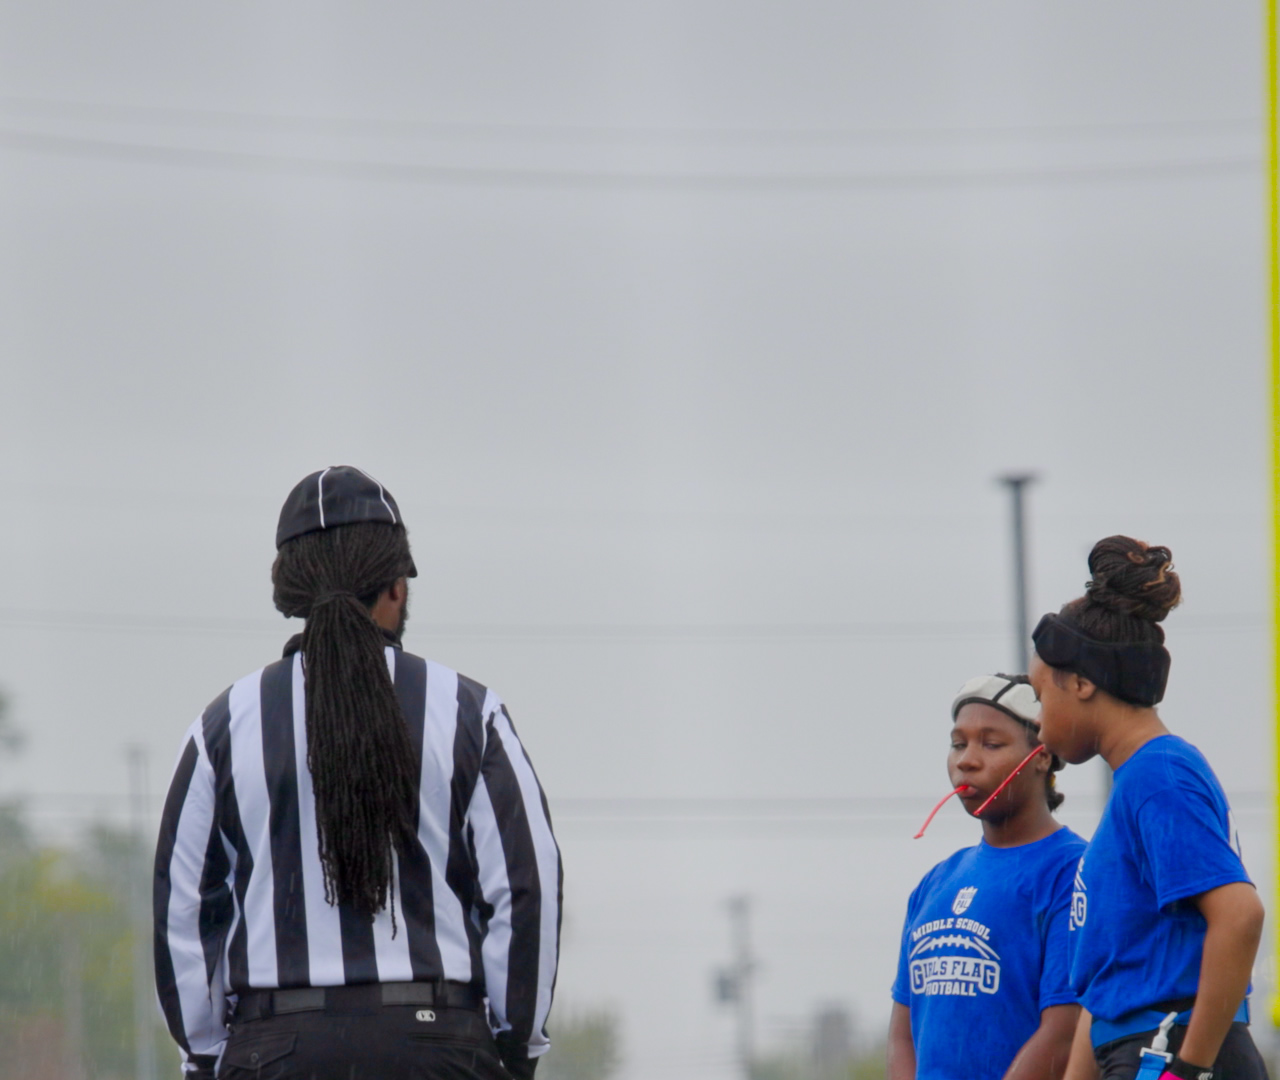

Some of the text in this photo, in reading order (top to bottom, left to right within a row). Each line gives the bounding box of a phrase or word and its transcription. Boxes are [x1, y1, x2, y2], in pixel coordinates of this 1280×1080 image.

[913, 917, 990, 942] MIDDLE SCHOOL
[910, 956, 1000, 994] GIRLS FLAG
